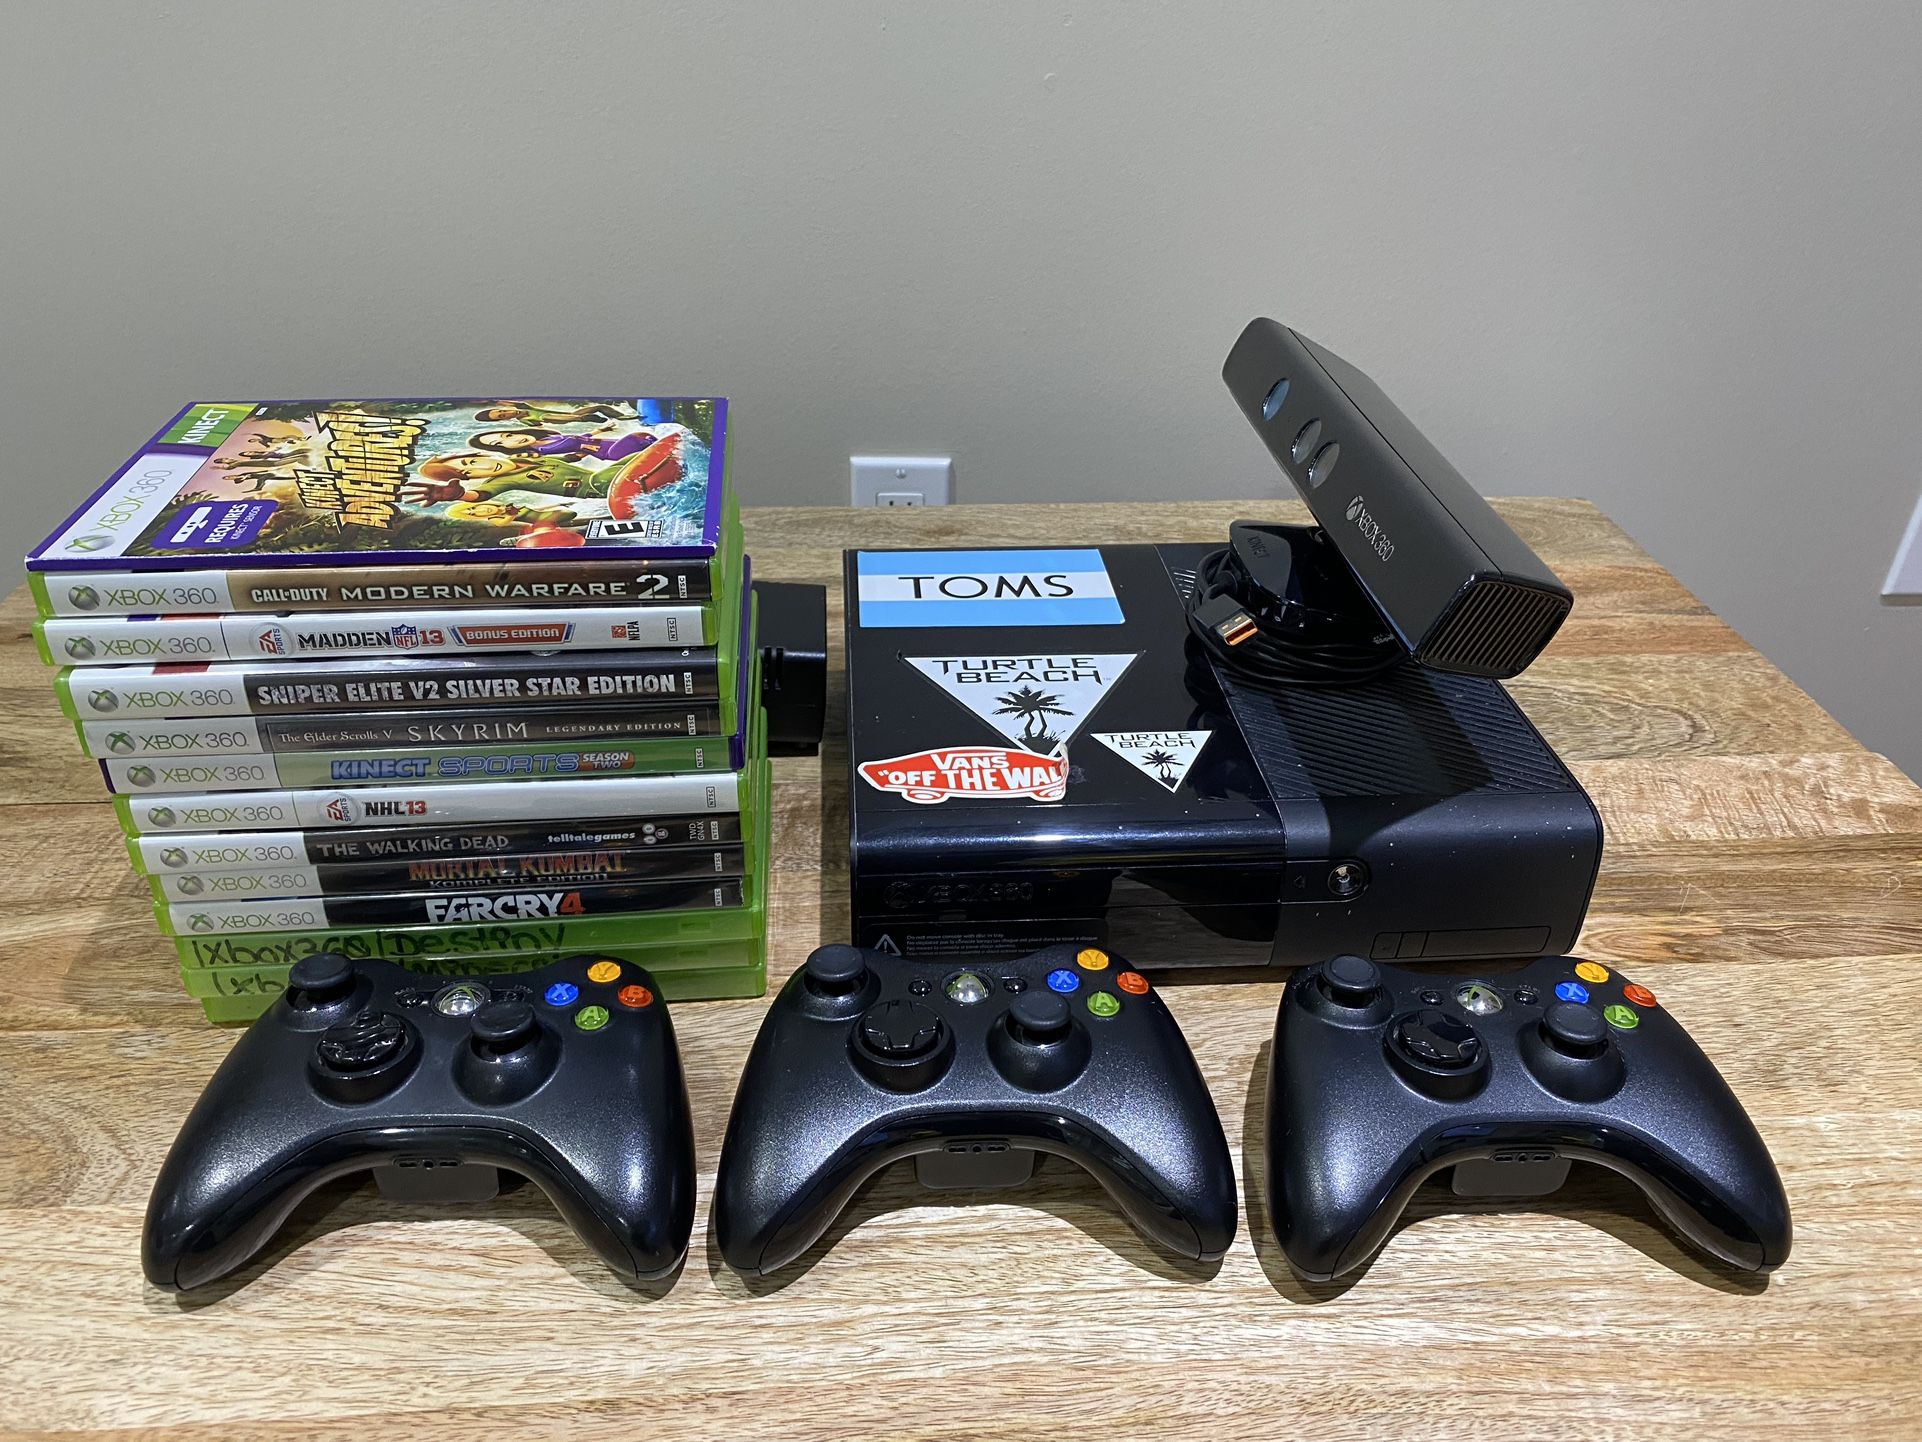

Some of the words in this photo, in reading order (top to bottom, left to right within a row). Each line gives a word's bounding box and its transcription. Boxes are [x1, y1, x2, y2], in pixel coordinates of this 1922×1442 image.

[178, 408, 230, 444] KINECT
[294, 469, 343, 510] KINECT
[89, 495, 150, 531] XBOX
[128, 469, 172, 494] 360
[204, 503, 249, 543] REQUIRES
[604, 521, 645, 536] E
[1355, 508, 1382, 545] XBOX
[1374, 534, 1395, 562] 360
[104, 588, 172, 606] XBOX
[172, 587, 217, 605] 360
[251, 588, 287, 603] CALL
[289, 587, 328, 601] DUTY
[341, 585, 474, 601] MODERN
[485, 582, 627, 598] WARFARE
[636, 574, 670, 599] 2
[679, 576, 687, 597] NTSC
[898, 574, 1074, 599] TOMS
[298, 631, 392, 649] MADDEN
[396, 635, 417, 648] NFL
[418, 629, 445, 645] 13
[466, 629, 509, 640] BONUS
[511, 628, 559, 639] EDITION
[668, 619, 677, 640] NTSC
[100, 638, 167, 656] XBOX
[168, 636, 212, 654] 360
[273, 628, 286, 655] SPORTS
[932, 657, 1097, 675] TURTLE
[684, 673, 693, 693] NTSC
[956, 670, 1103, 686] BEACH
[123, 690, 188, 708] XBOX
[189, 689, 233, 706] 360
[257, 683, 341, 705] SNIPER
[345, 681, 404, 702] ELITE
[408, 680, 440, 700] V2
[445, 678, 521, 699] SILVER
[526, 676, 582, 697] STAR
[587, 674, 677, 695] EDITION
[278, 733, 300, 743] The
[303, 732, 337, 744] Elder
[339, 730, 379, 742] Scrolls
[383, 729, 392, 740] V
[407, 722, 528, 742] SKYRIM
[546, 724, 621, 734] LEGENDARY
[627, 721, 681, 731] EDITION
[688, 715, 696, 734] NTSC
[139, 733, 204, 750] XBOX
[204, 731, 247, 749] 360
[1104, 732, 1193, 744] TURTLE
[1118, 739, 1196, 750] BEACH
[331, 758, 431, 780] KINECT
[438, 752, 579, 776] SPORTS
[582, 752, 630, 762] SEASON
[592, 760, 622, 769] TWO
[930, 752, 1010, 770] VANS
[159, 767, 222, 783] XBOX
[223, 765, 264, 782] 360
[941, 768, 998, 791] THE
[1001, 765, 1065, 790] WAL
[707, 787, 715, 807] NTSC
[180, 807, 242, 823] XBOX
[243, 806, 283, 822] 360
[340, 797, 352, 822] SPORTS
[365, 801, 406, 816] NHL
[406, 800, 427, 815] 13
[316, 843, 360, 857] THE
[366, 838, 453, 854] WALKING
[460, 835, 510, 850] DEAD
[547, 832, 636, 844] telltalegames
[192, 848, 253, 864] XBOX
[254, 846, 294, 862] 360
[409, 856, 515, 881] MORTAL
[519, 851, 624, 876] KOMBAT
[209, 875, 267, 892] XBOX
[268, 874, 307, 890] 360
[560, 892, 586, 915] 4
[217, 913, 276, 929] XBOX
[276, 911, 315, 927] 360
